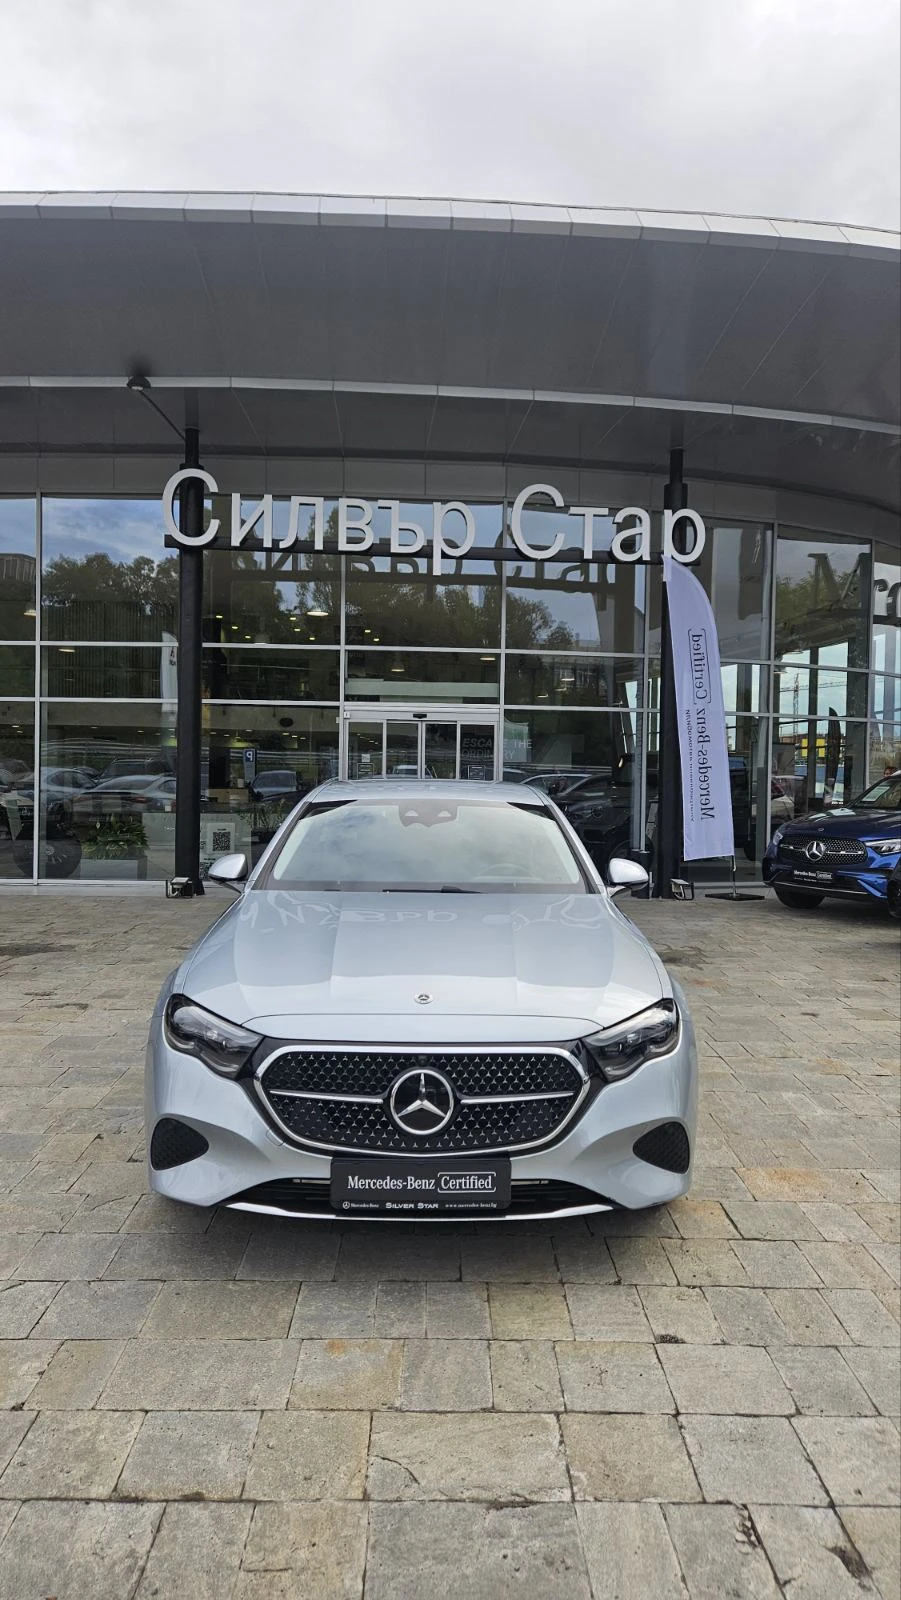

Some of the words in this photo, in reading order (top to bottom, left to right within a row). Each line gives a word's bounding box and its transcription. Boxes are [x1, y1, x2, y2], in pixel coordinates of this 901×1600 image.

[162, 468, 476, 576] Силвър
[511, 483, 706, 582] Стар
[347, 1175, 436, 1189] Mercedes-Benz
[441, 1175, 492, 1189] Certified
